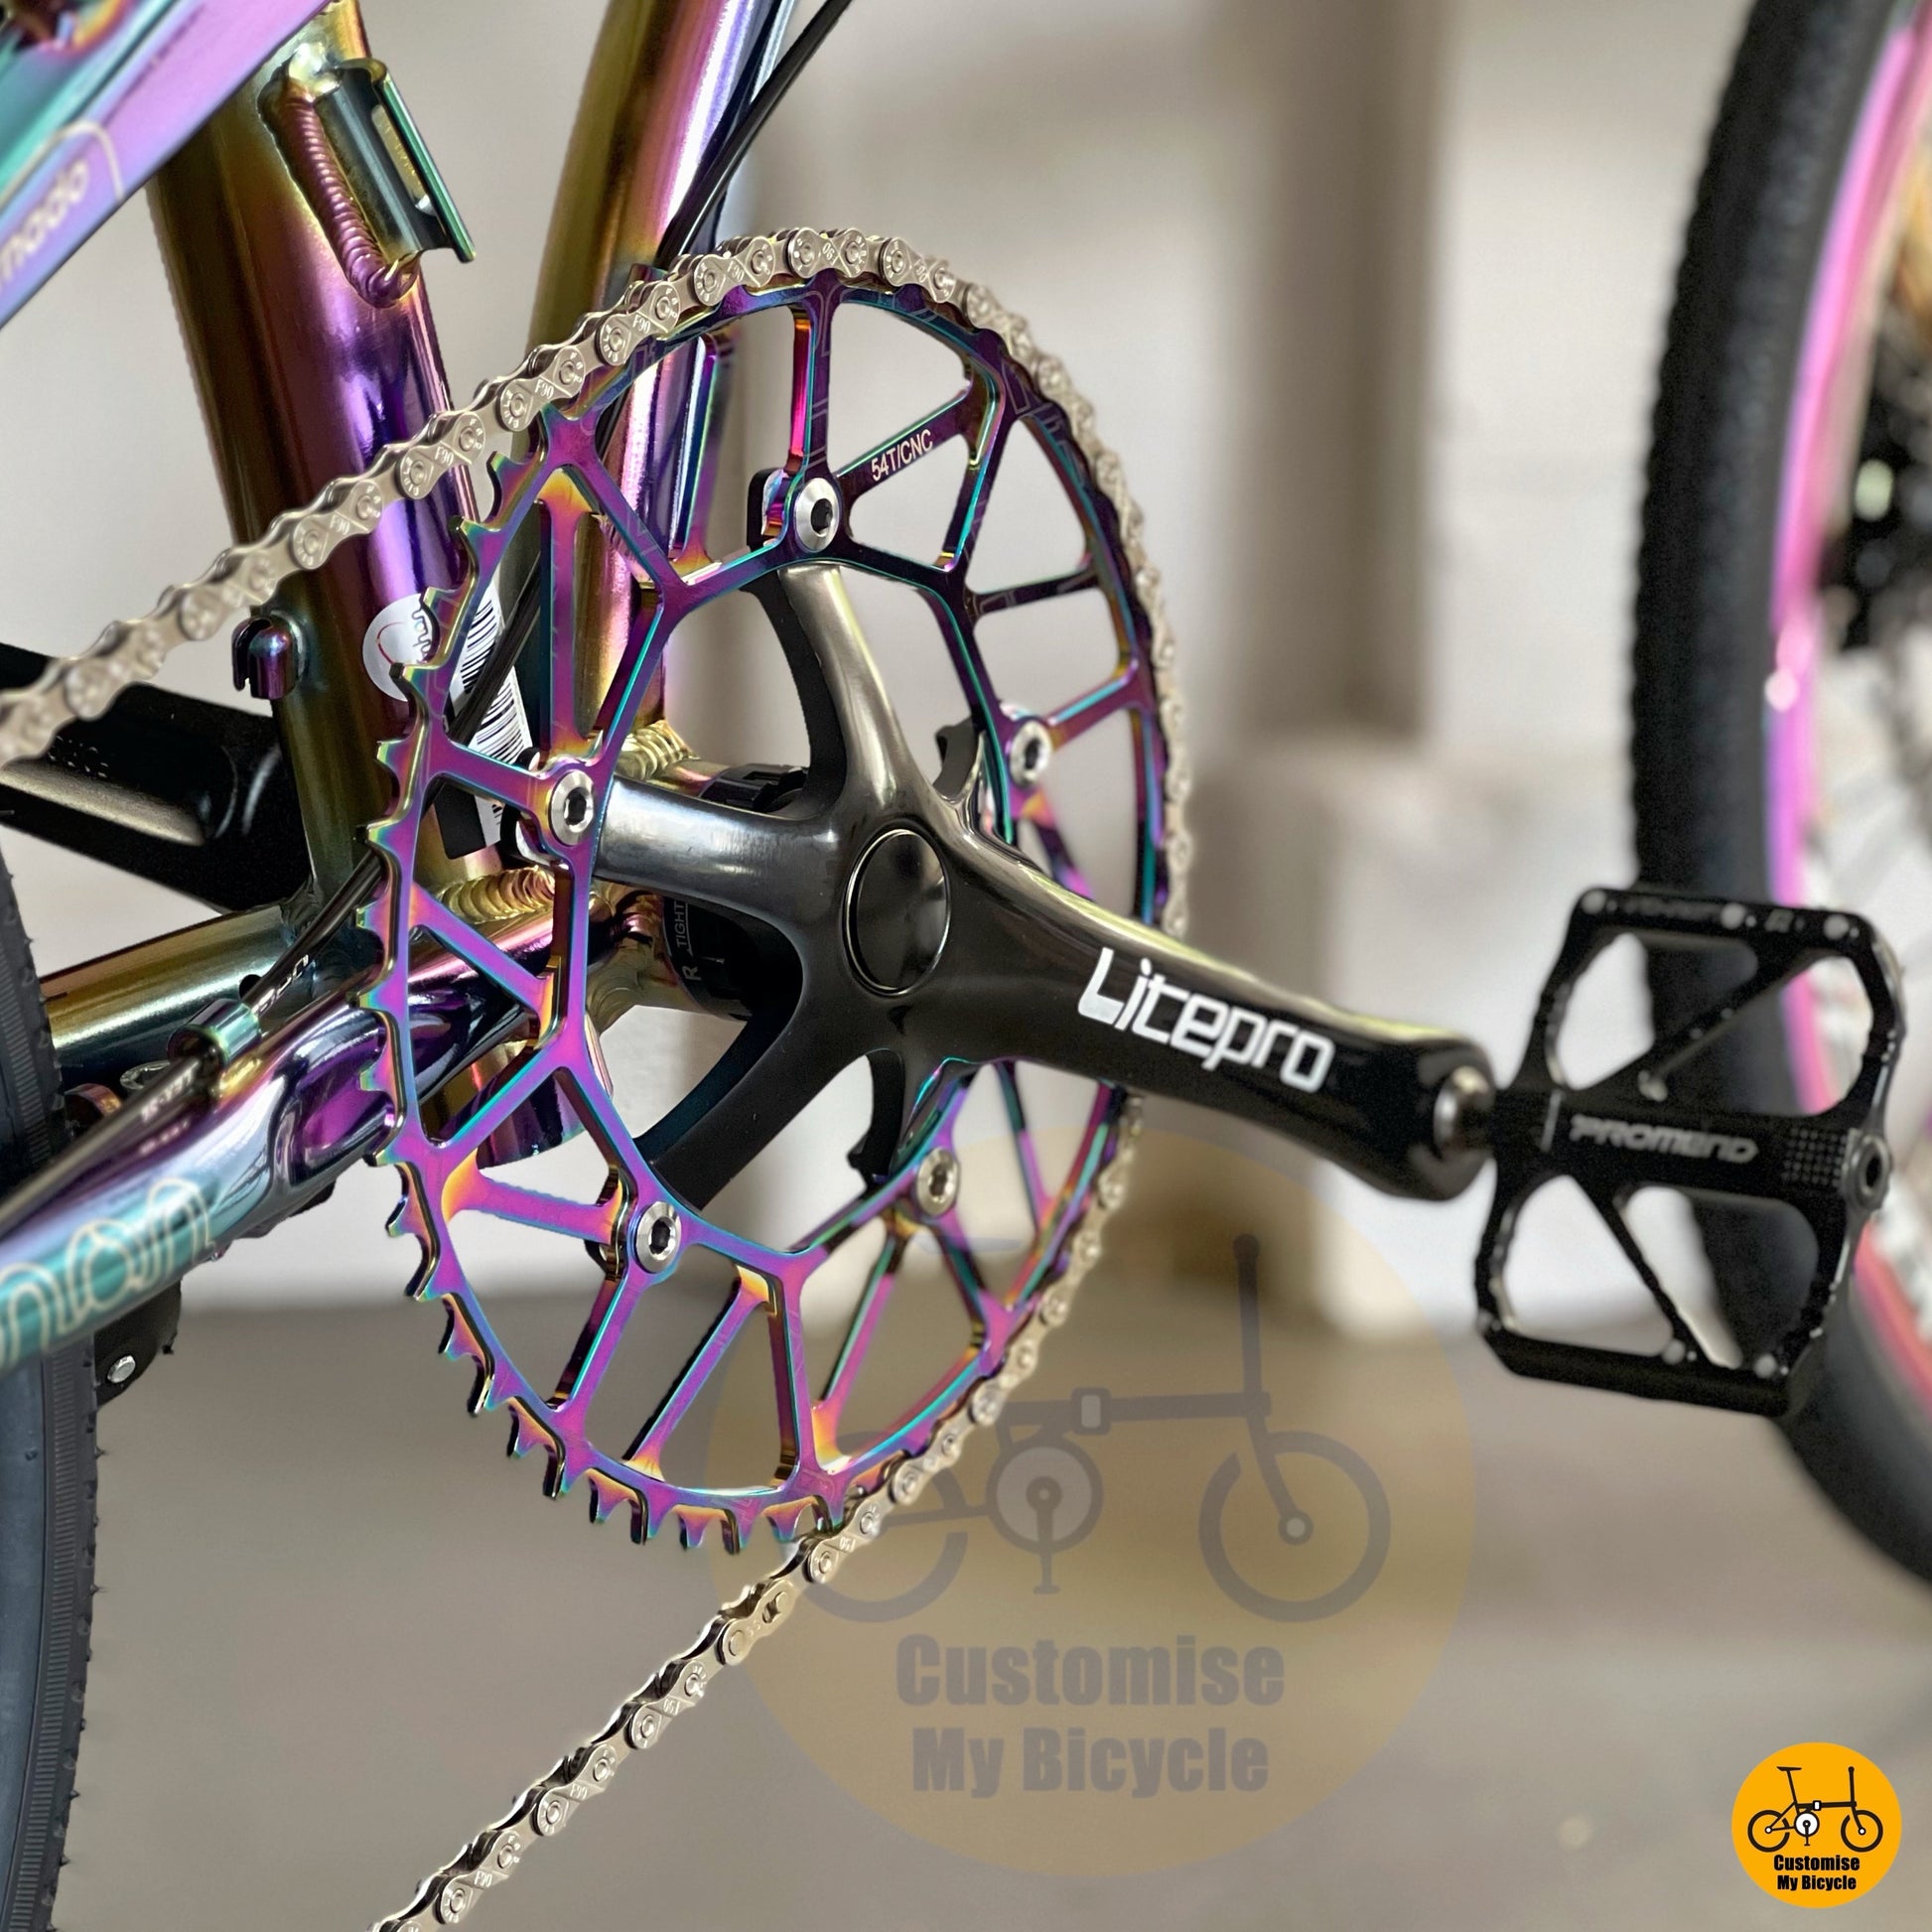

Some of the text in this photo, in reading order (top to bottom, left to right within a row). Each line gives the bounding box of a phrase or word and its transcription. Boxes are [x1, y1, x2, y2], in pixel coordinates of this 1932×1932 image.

[632, 314, 651, 334] F90
[534, 379, 555, 398] F90
[435, 446, 455, 468] F90
[871, 429, 933, 482] 54T/CNC
[673, 898, 687, 948] TIGHT
[1078, 946, 1335, 1093] Litepro
